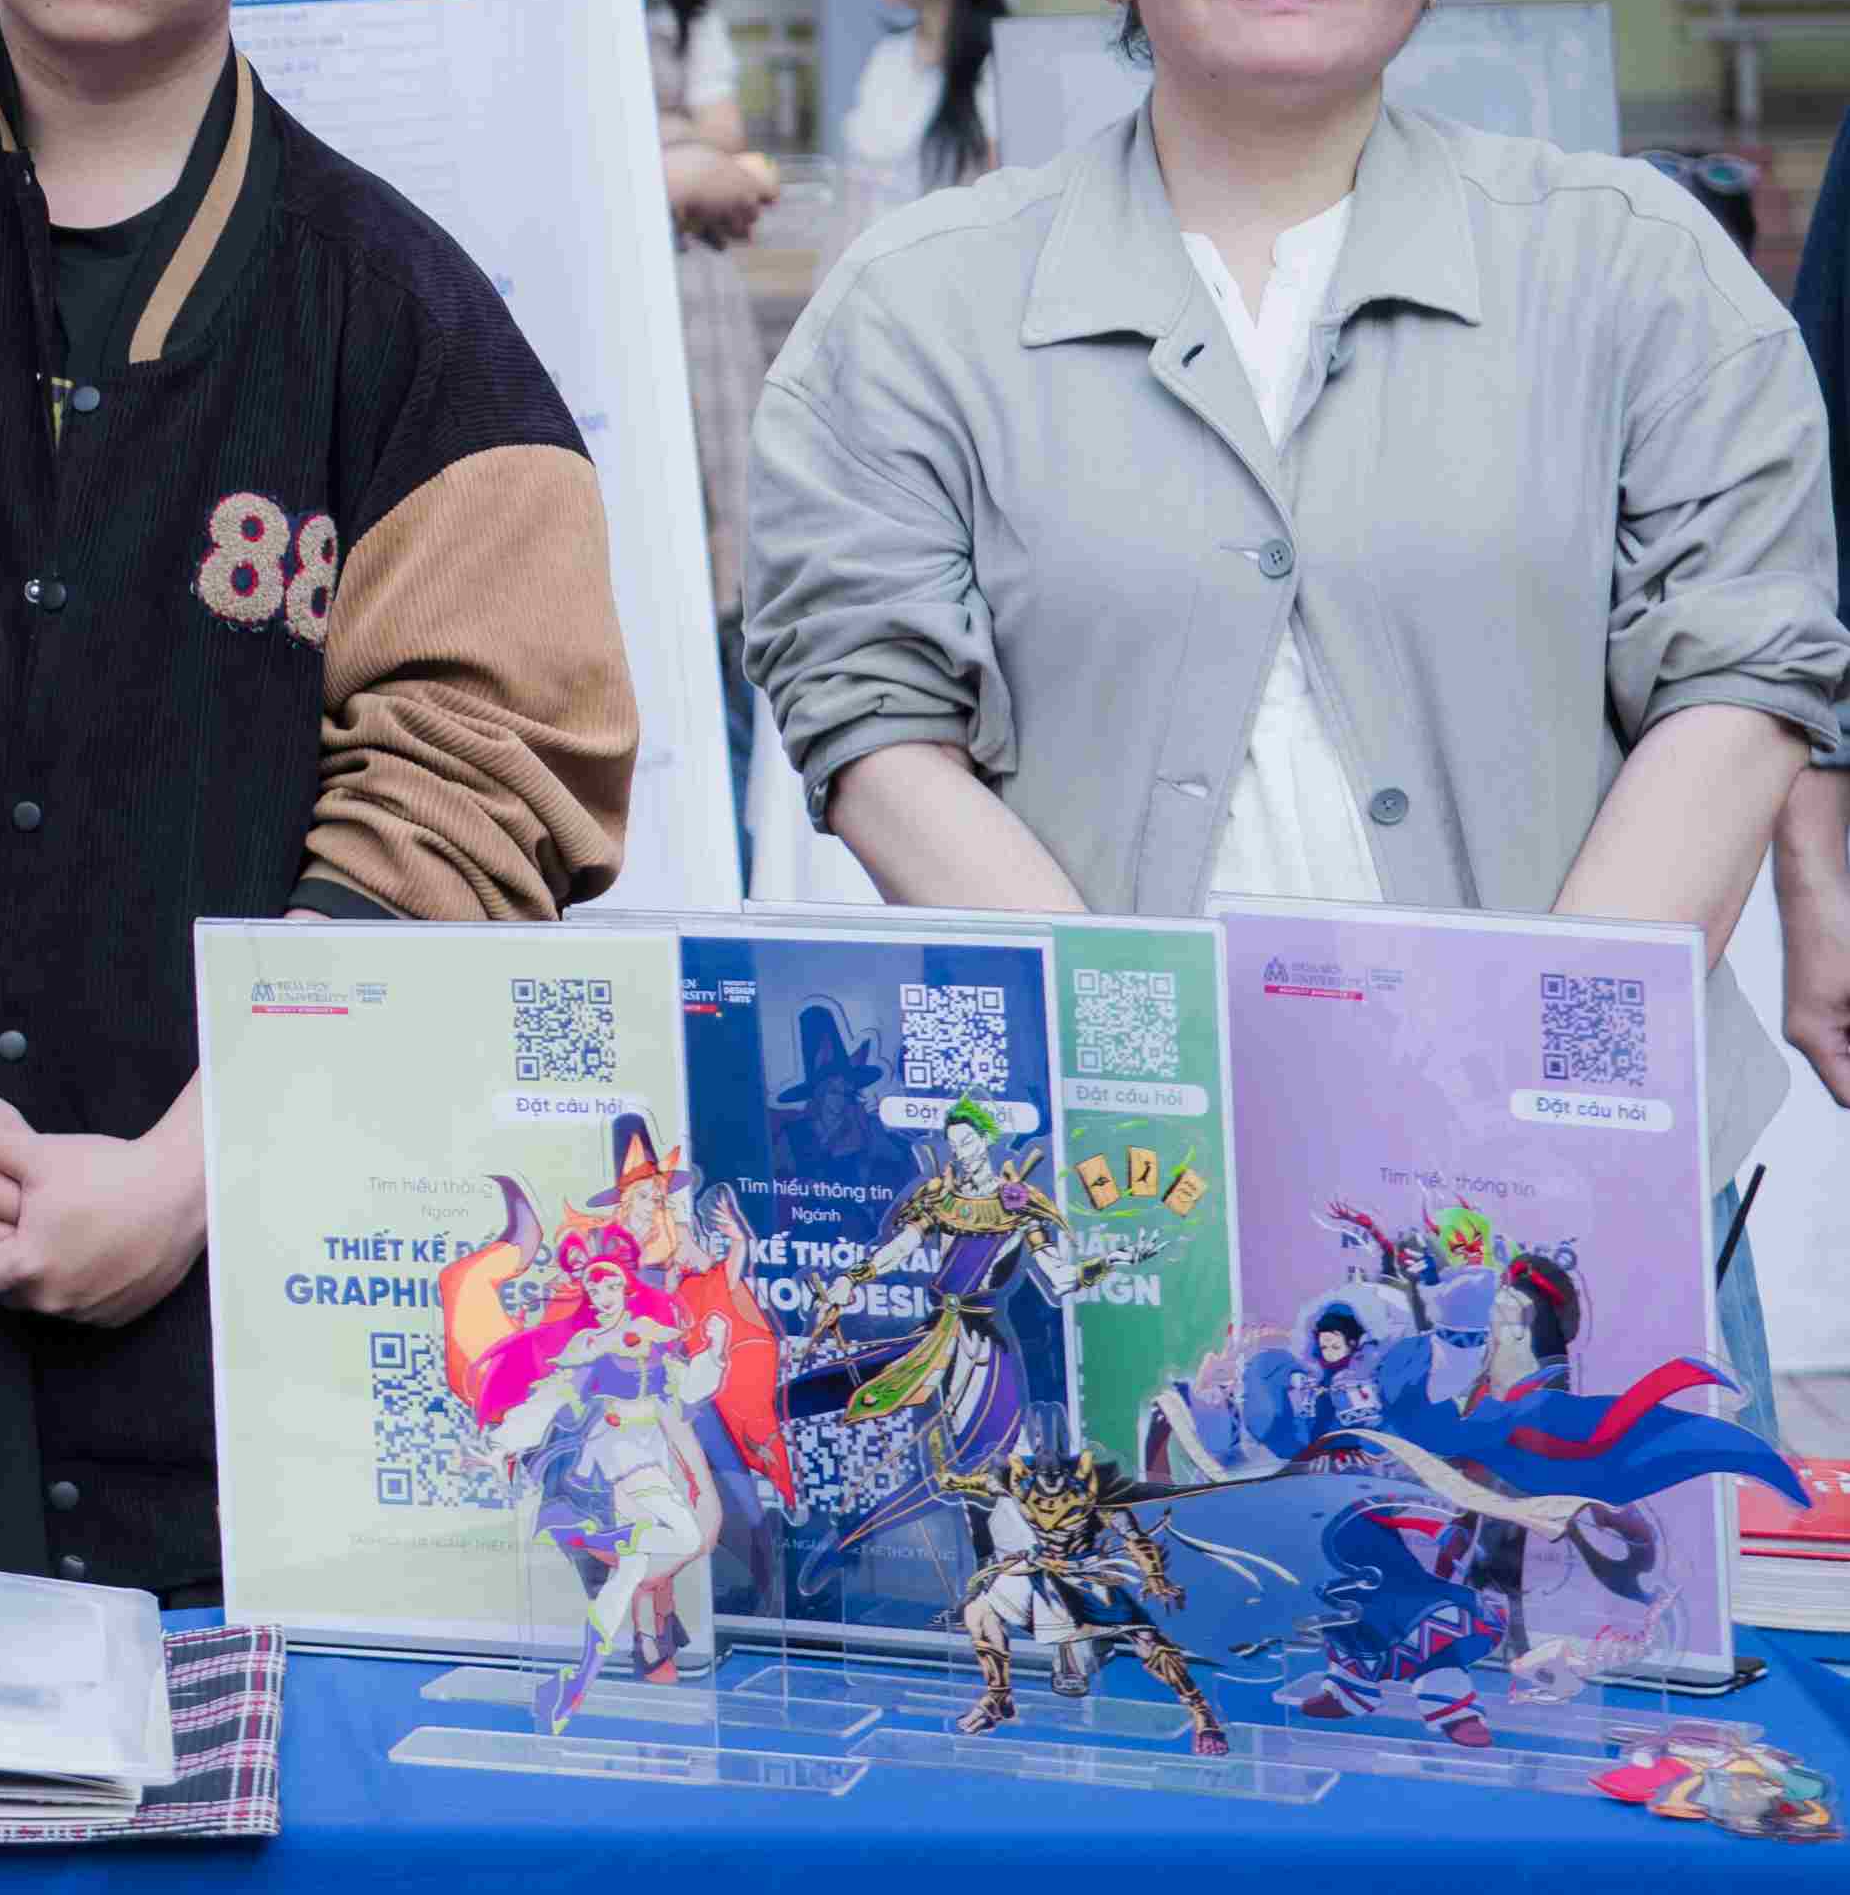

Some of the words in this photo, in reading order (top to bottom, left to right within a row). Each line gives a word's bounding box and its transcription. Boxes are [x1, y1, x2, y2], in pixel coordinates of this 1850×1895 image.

[197, 491, 338, 653] 88
[515, 1097, 550, 1117] Đặt
[555, 1099, 589, 1114] câu
[1075, 1084, 1109, 1106] Đặt
[1115, 1088, 1150, 1105] câu
[1155, 1088, 1183, 1106] hỏi
[905, 1103, 938, 1125] Đặt
[1536, 1097, 1570, 1119] Đặt
[1577, 1101, 1612, 1119] câu
[1617, 1104, 1647, 1122] hỏi
[773, 1178, 809, 1196] hiểu
[813, 1181, 865, 1203] thông
[870, 1184, 893, 1201] tin
[324, 1229, 404, 1263] THIẾT
[411, 1230, 452, 1264] KẾ
